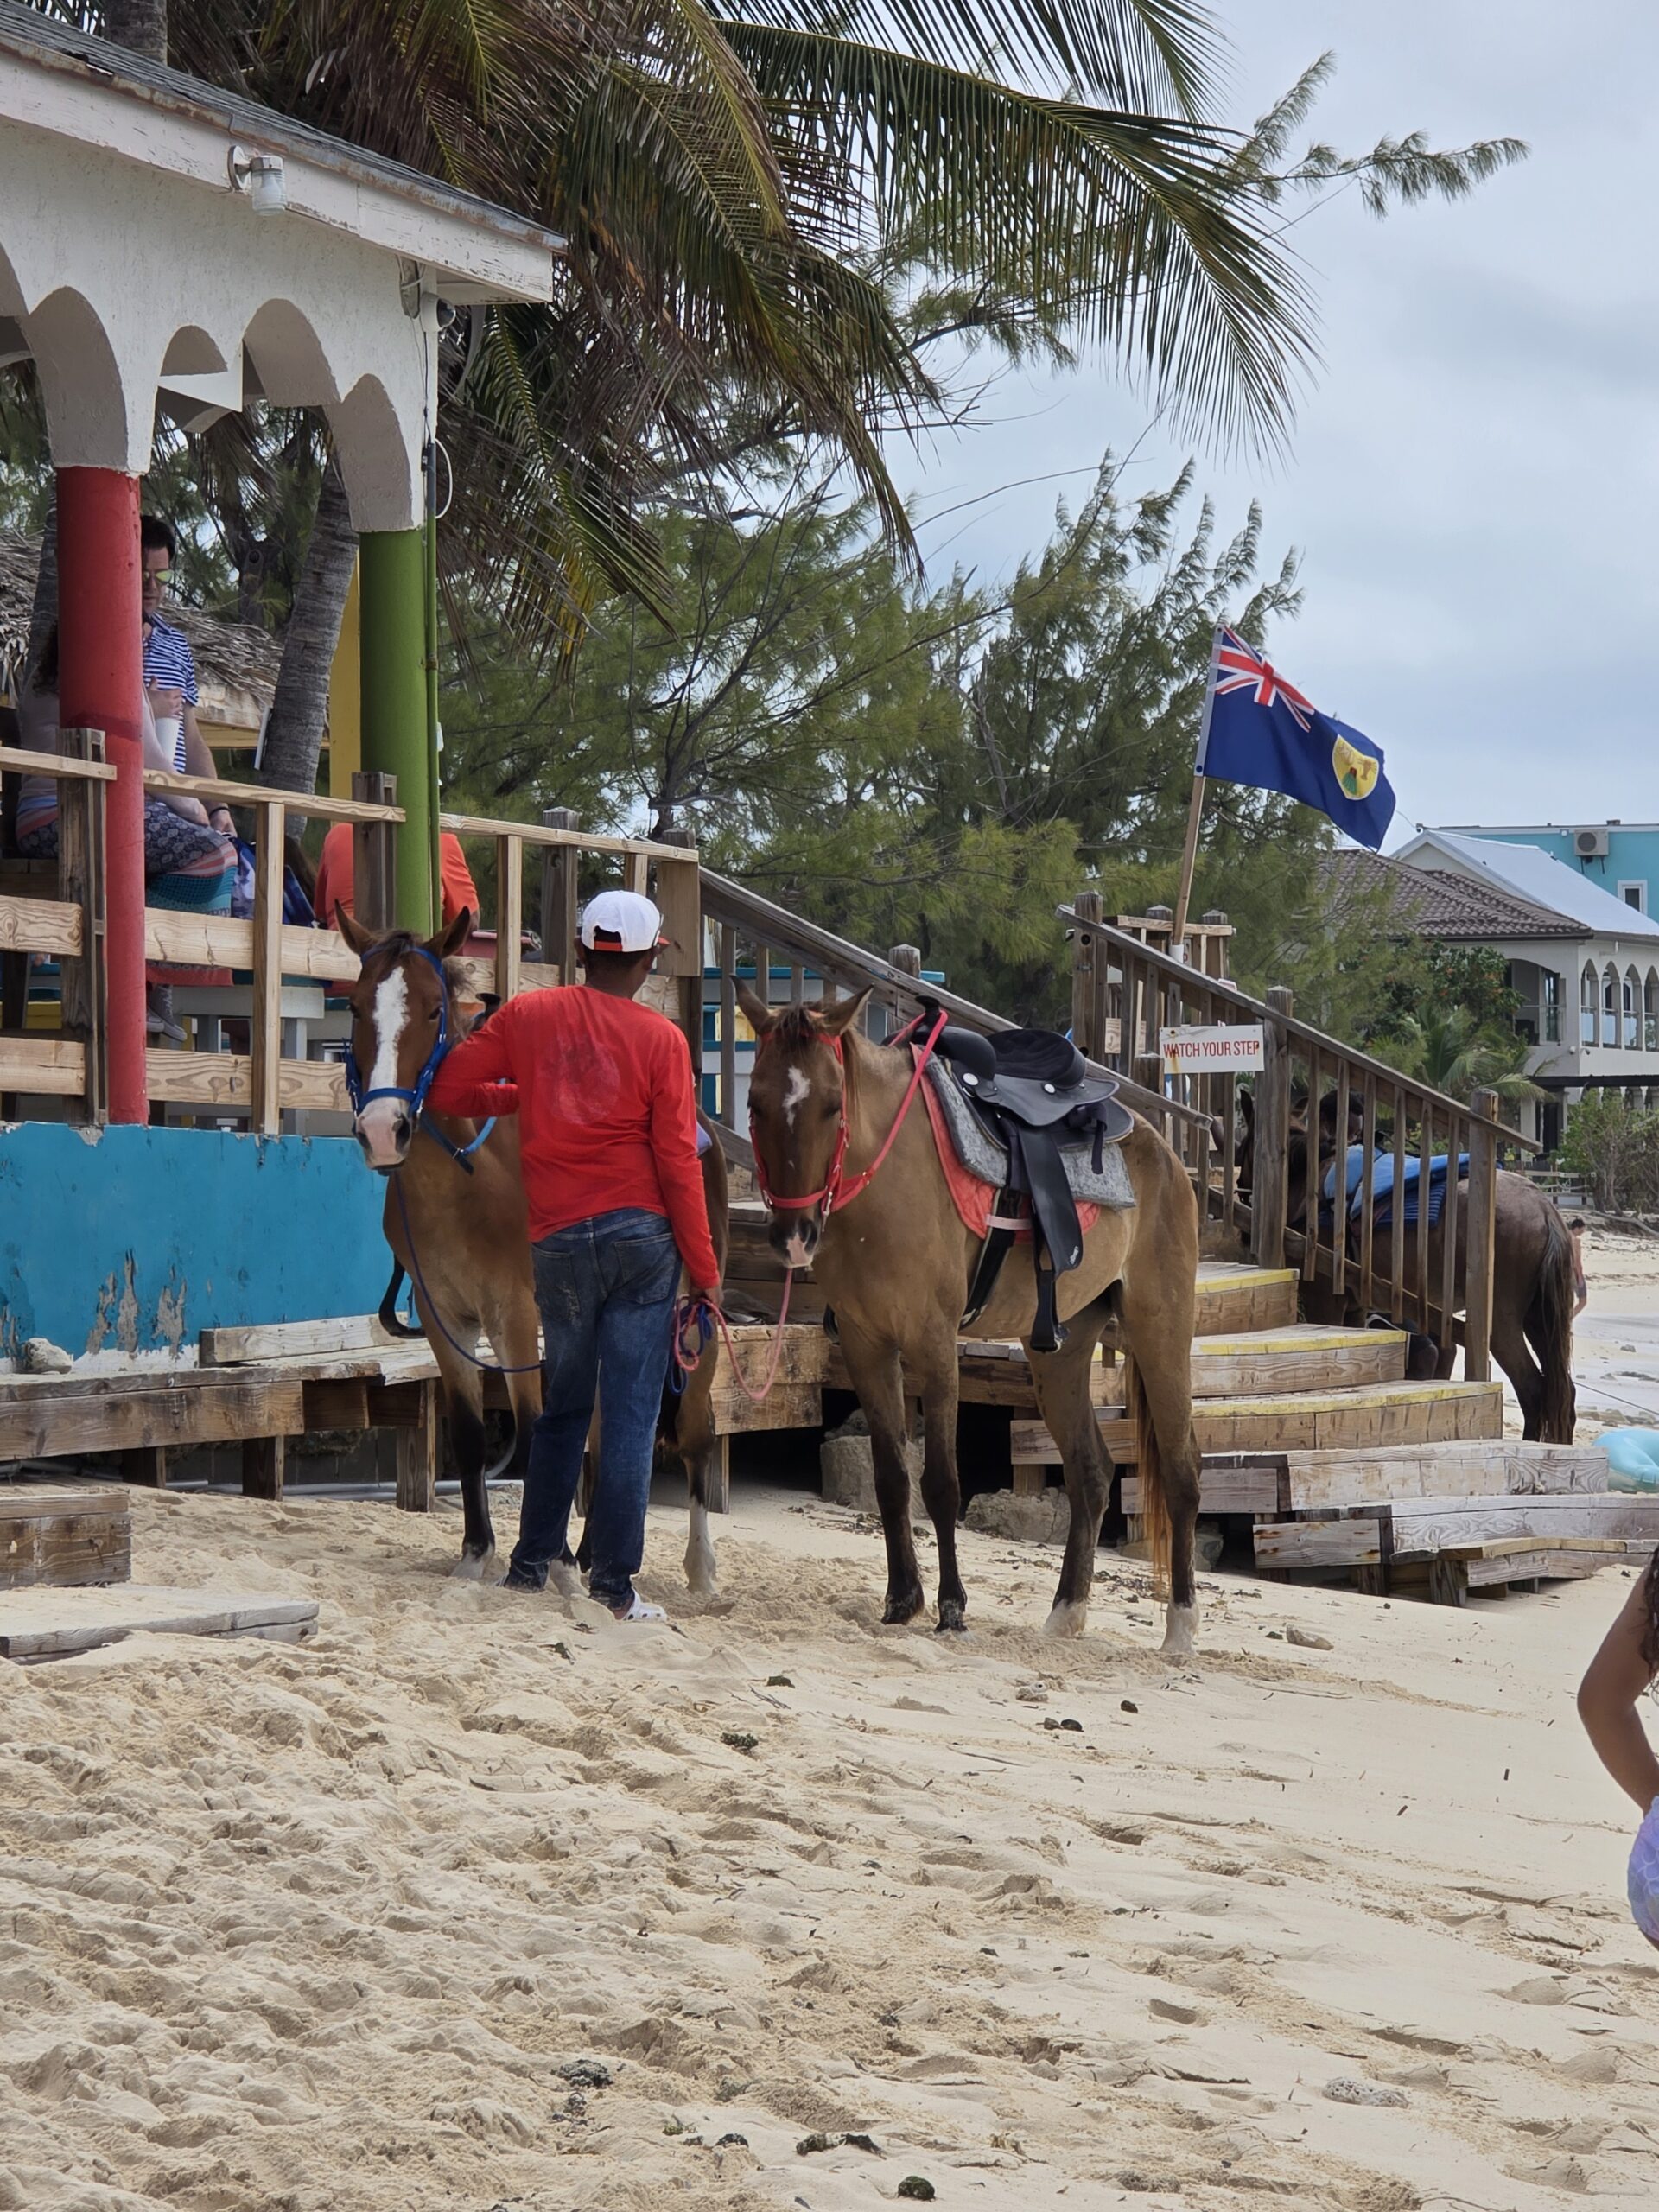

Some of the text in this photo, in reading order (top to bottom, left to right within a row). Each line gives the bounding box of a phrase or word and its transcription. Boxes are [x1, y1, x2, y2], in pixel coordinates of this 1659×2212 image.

[1163, 1040, 1260, 1058] WATCH YOUR STEP
